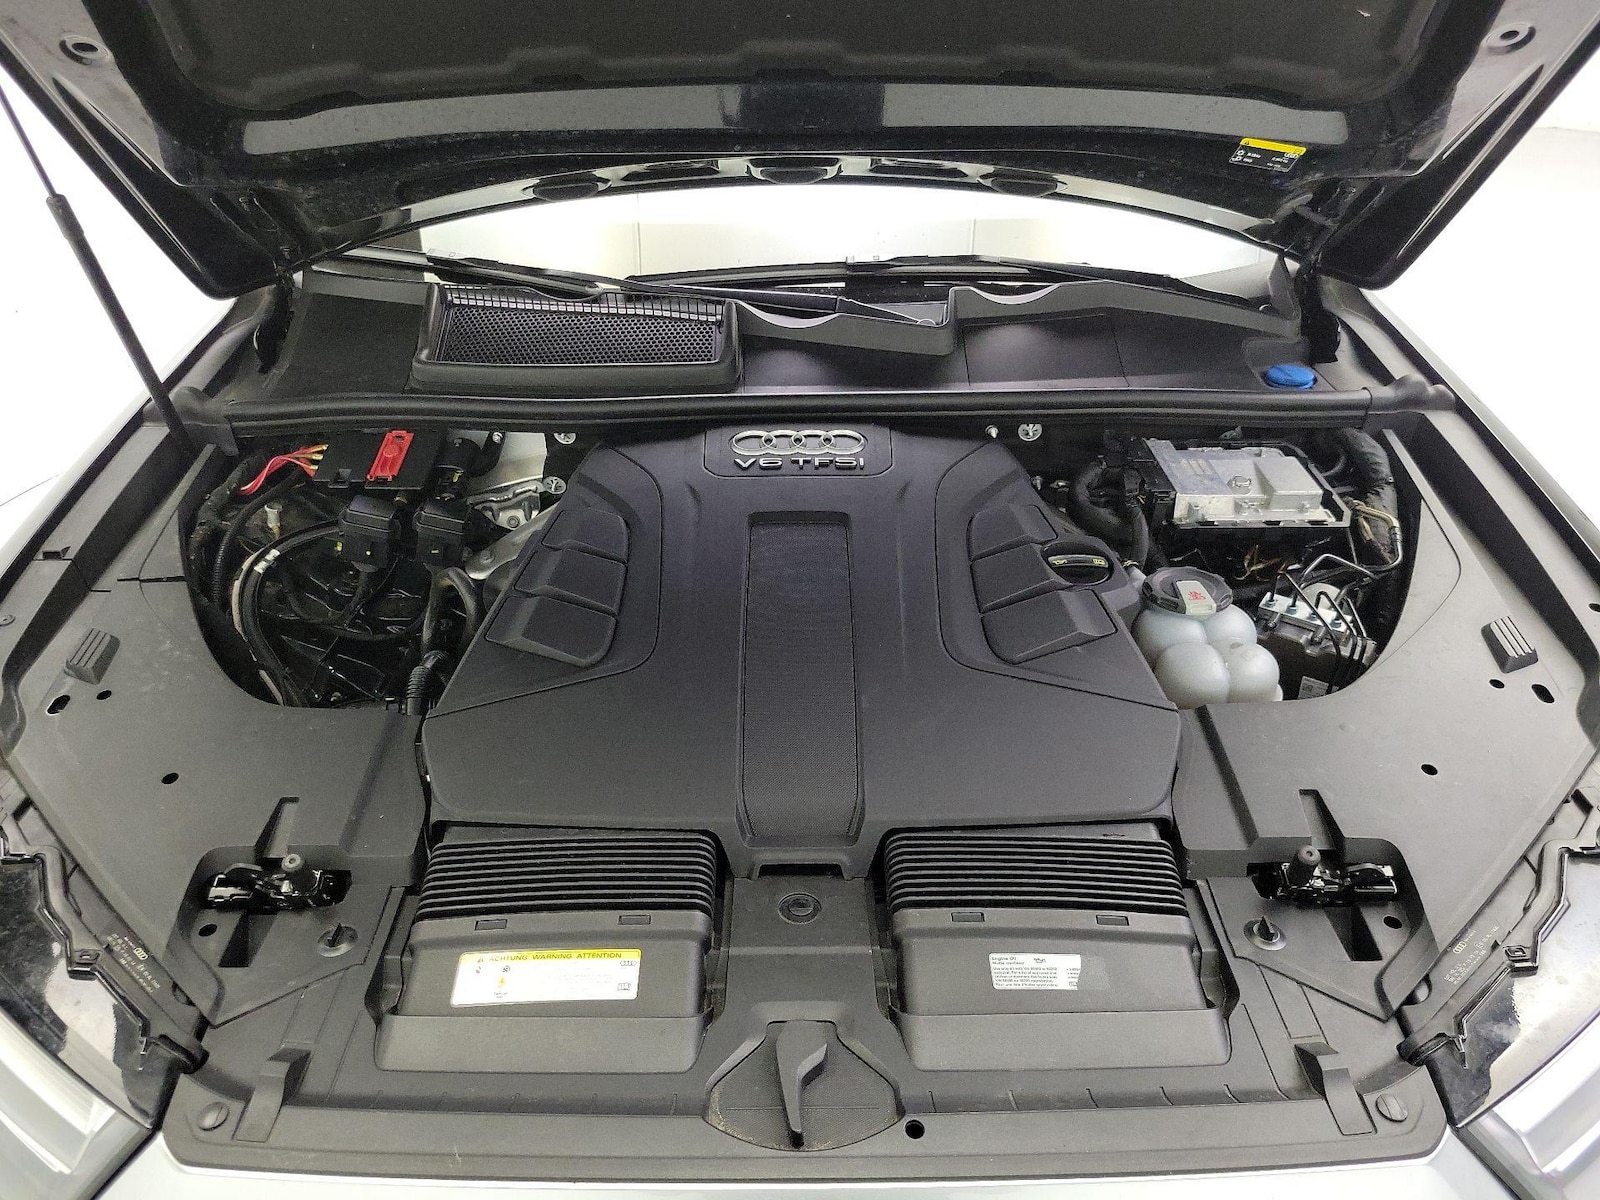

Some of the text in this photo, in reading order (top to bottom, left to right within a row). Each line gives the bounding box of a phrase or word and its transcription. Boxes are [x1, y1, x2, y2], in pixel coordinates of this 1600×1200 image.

[734, 457, 865, 470] V6 TFSI
[489, 952, 622, 962] ACHTUNG WARNING ATTENTION
